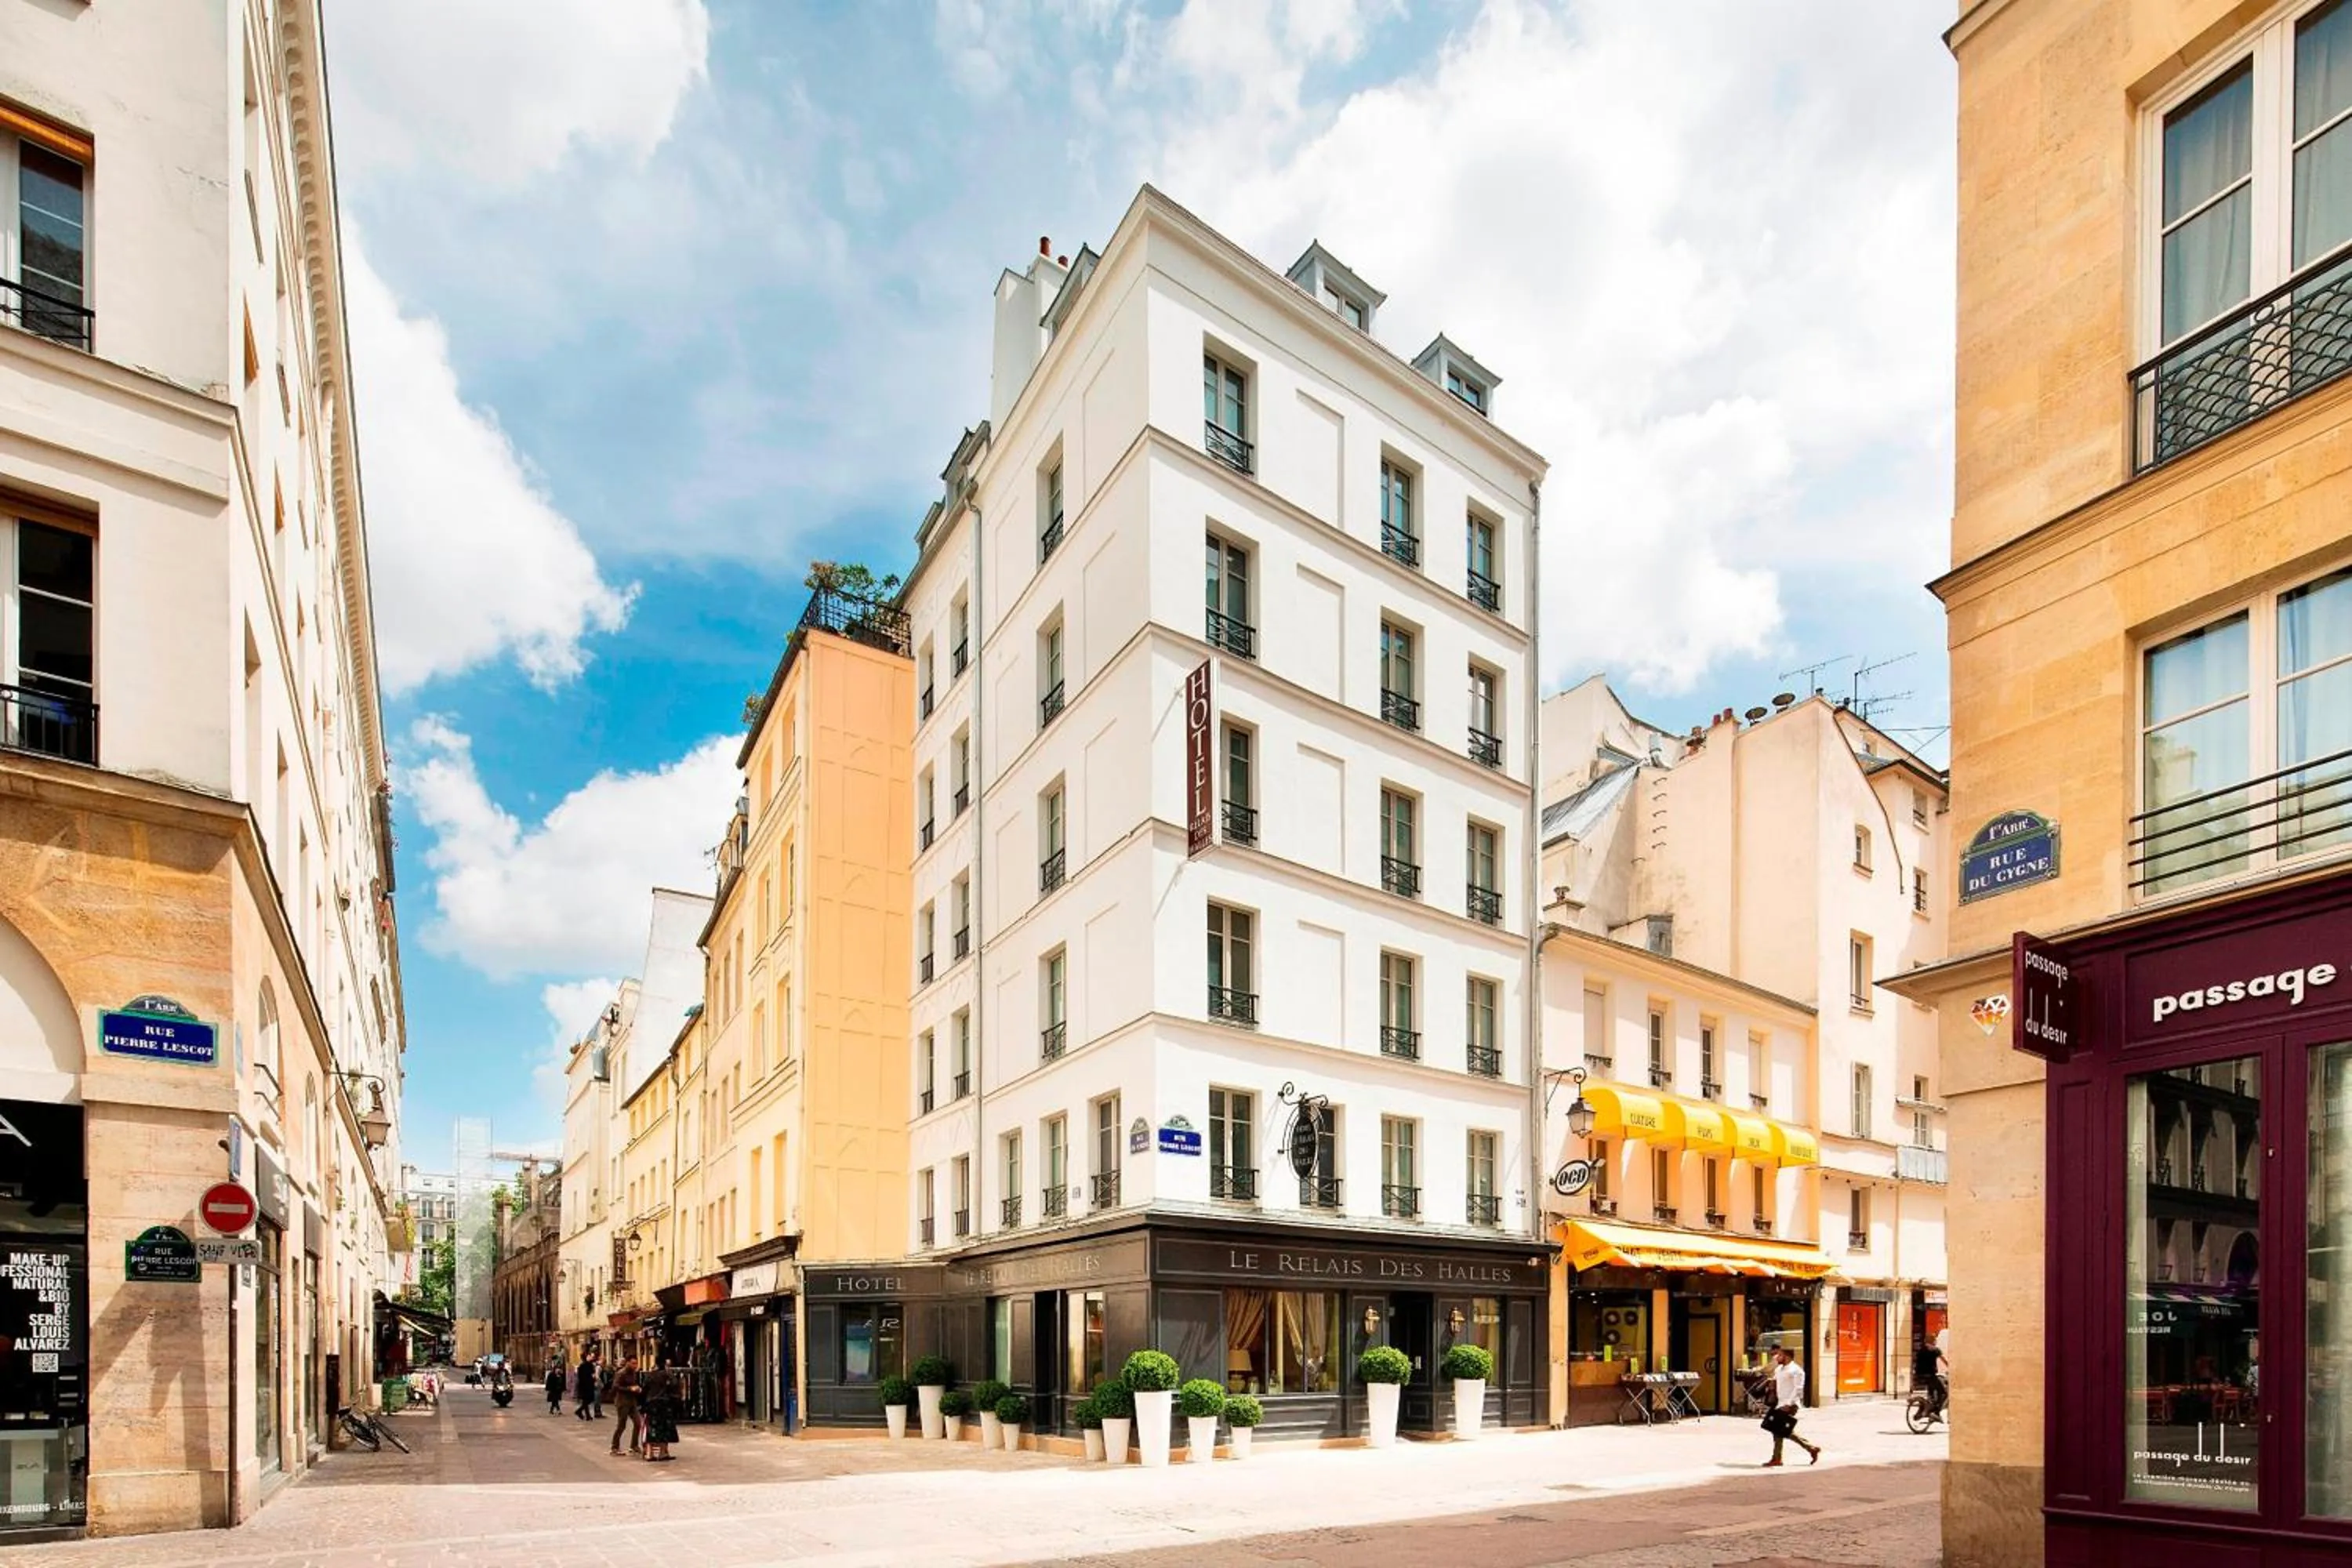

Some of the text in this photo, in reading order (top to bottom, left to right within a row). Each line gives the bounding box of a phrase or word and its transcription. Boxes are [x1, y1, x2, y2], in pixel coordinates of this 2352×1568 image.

[1191, 666, 1208, 817] HOTEL
[1990, 848, 2027, 869] RUE
[1969, 857, 2049, 891] DU CYGNE
[2025, 950, 2068, 989] passage
[2154, 964, 2336, 1022] passage
[2025, 987, 2038, 1036] du
[144, 1025, 175, 1038] RUE
[104, 1035, 214, 1056] PIERRE LESCOT
[1630, 1113, 1656, 1127] CULTURE
[1559, 1167, 1586, 1185] OCD
[9, 1252, 70, 1266] MAKE-UP
[131, 1255, 195, 1265] PIERRE LESCOT
[1230, 1250, 1512, 1282] LE RELAIS DES HALLES
[0, 1265, 71, 1279] FESSIONAL
[13, 1277, 71, 1290] NATURAL
[38, 1290, 70, 1302] &BIO
[54, 1302, 71, 1314] BY
[28, 1313, 70, 1327] SERGE
[32, 1326, 70, 1338] LOUIS
[14, 1338, 70, 1351] ALVAREZ
[2133, 1451, 2190, 1467] passage
[2194, 1421, 2211, 1462] du
